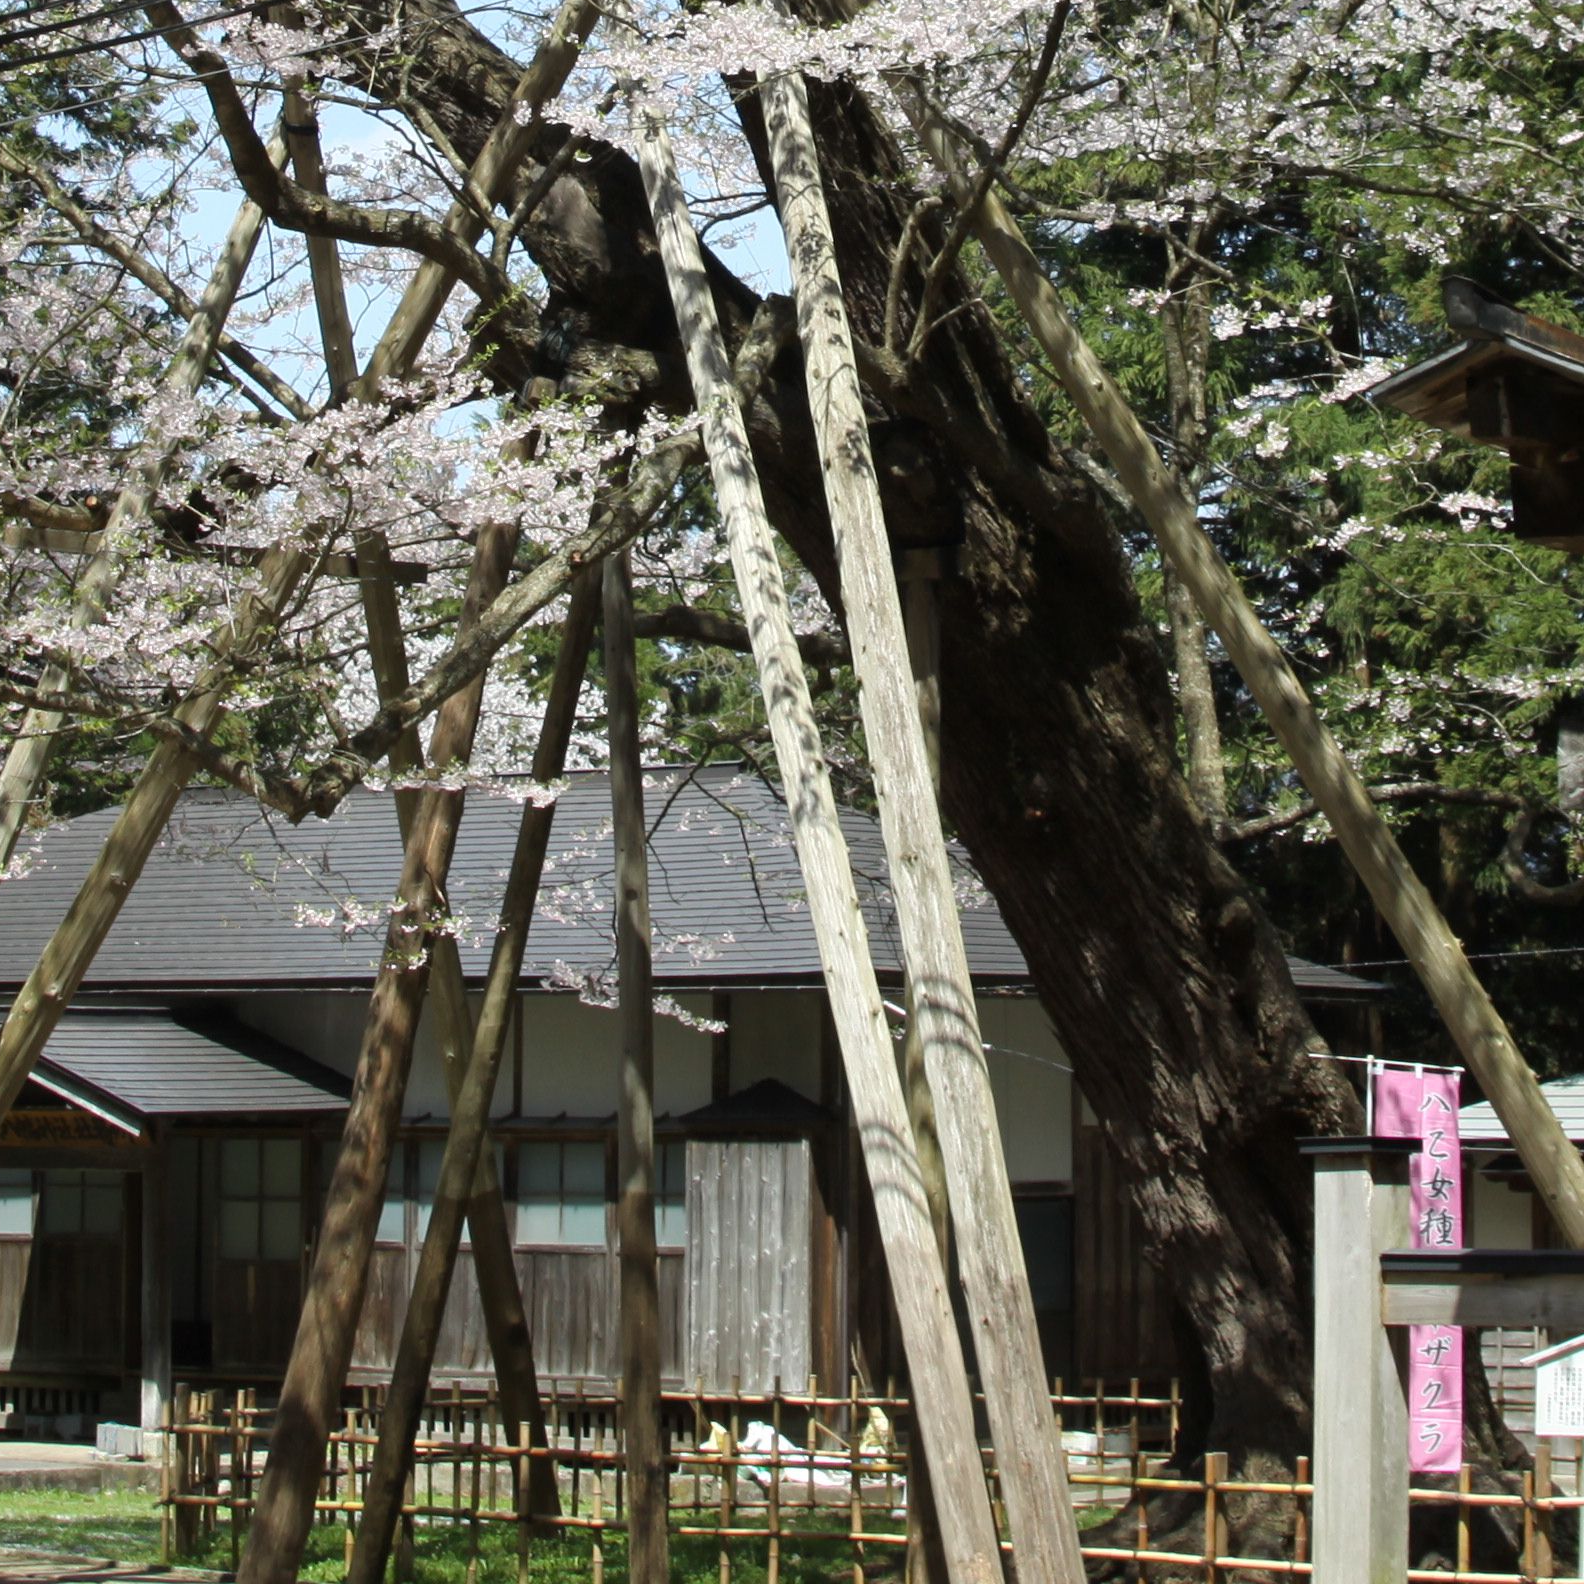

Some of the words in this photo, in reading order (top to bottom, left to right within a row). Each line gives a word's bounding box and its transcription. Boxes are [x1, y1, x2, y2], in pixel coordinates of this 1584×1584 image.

[1419, 1093, 1456, 1453] 八乙女種ザクラ
